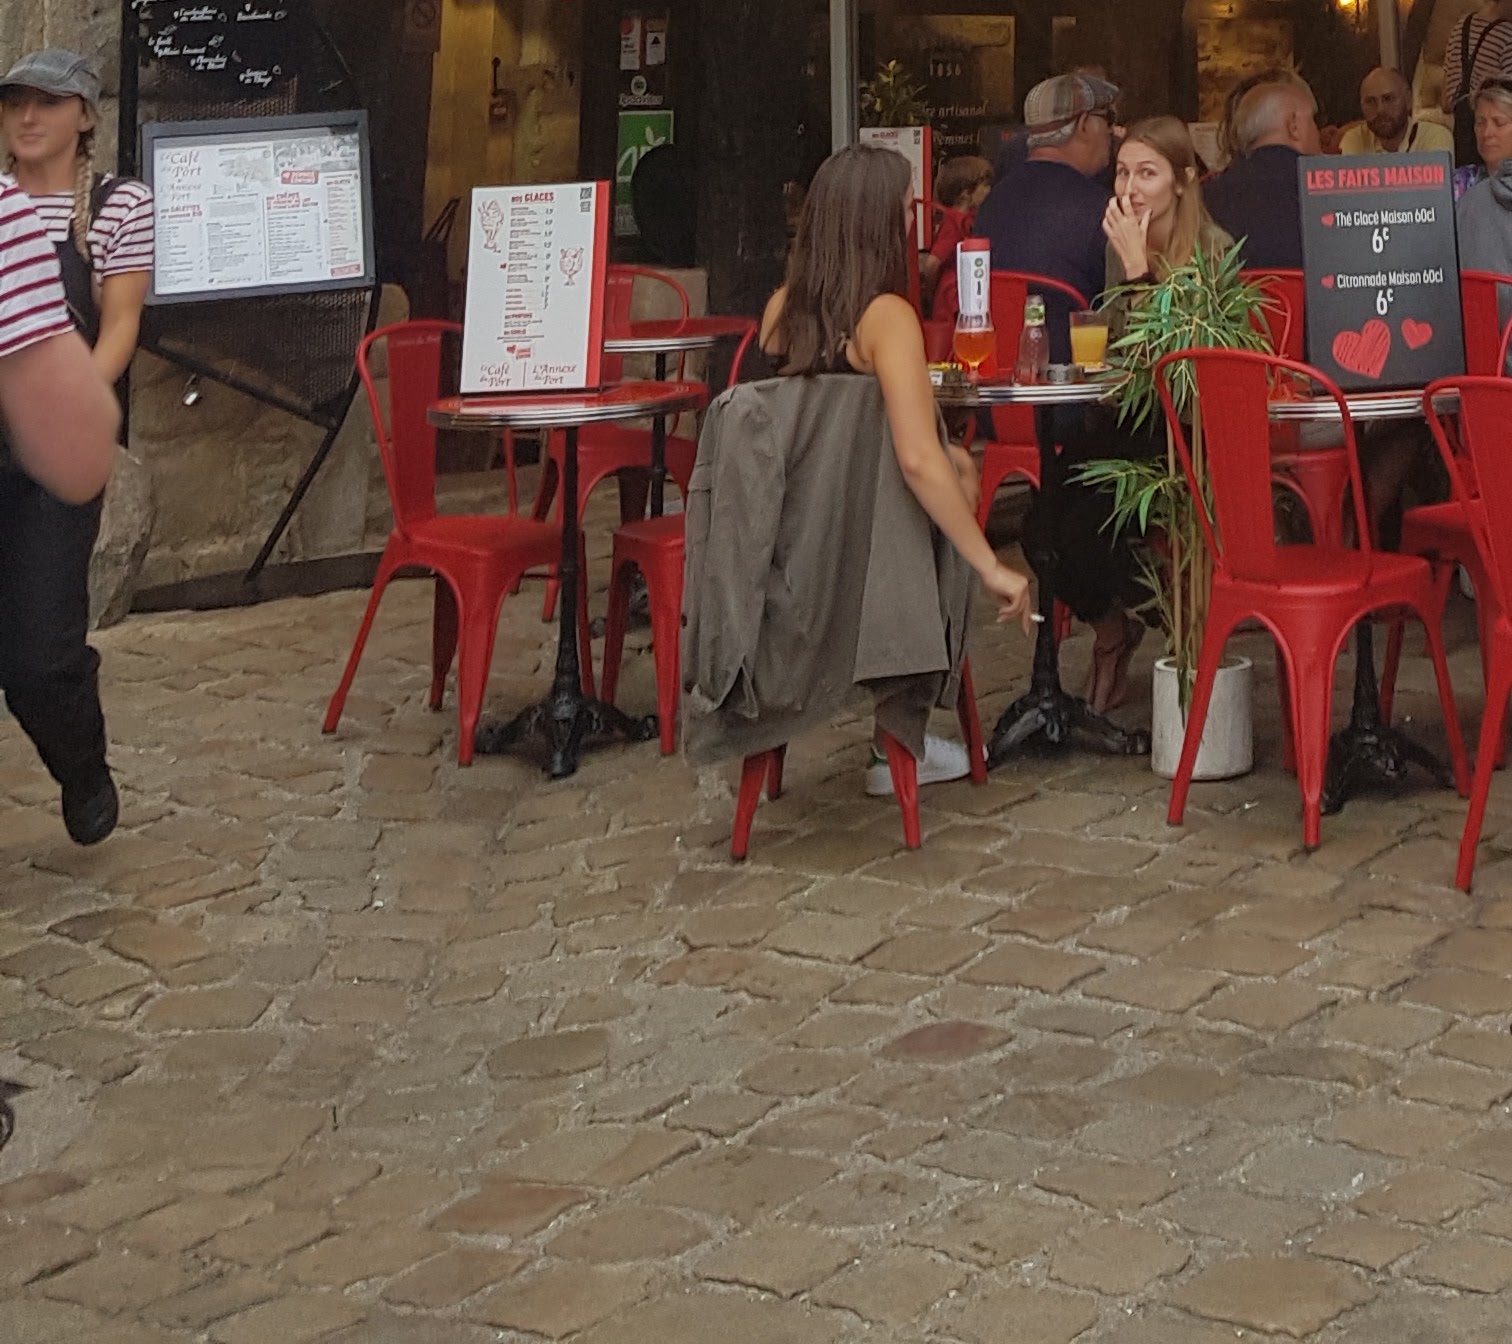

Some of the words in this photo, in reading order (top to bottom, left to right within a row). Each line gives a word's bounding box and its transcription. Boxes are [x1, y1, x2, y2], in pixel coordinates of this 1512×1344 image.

[1306, 169, 1335, 190] LES
[1338, 167, 1381, 188] FAITS
[1384, 165, 1445, 186] MAISON
[524, 192, 555, 203] GLACES
[1335, 211, 1352, 227] Thé
[1353, 210, 1379, 226] Glacé
[1381, 210, 1414, 225] Maison
[1415, 207, 1435, 223] 60cl
[1337, 270, 1388, 289] Citronnade
[1389, 270, 1422, 285] Maison
[1423, 267, 1444, 283] 60cl
